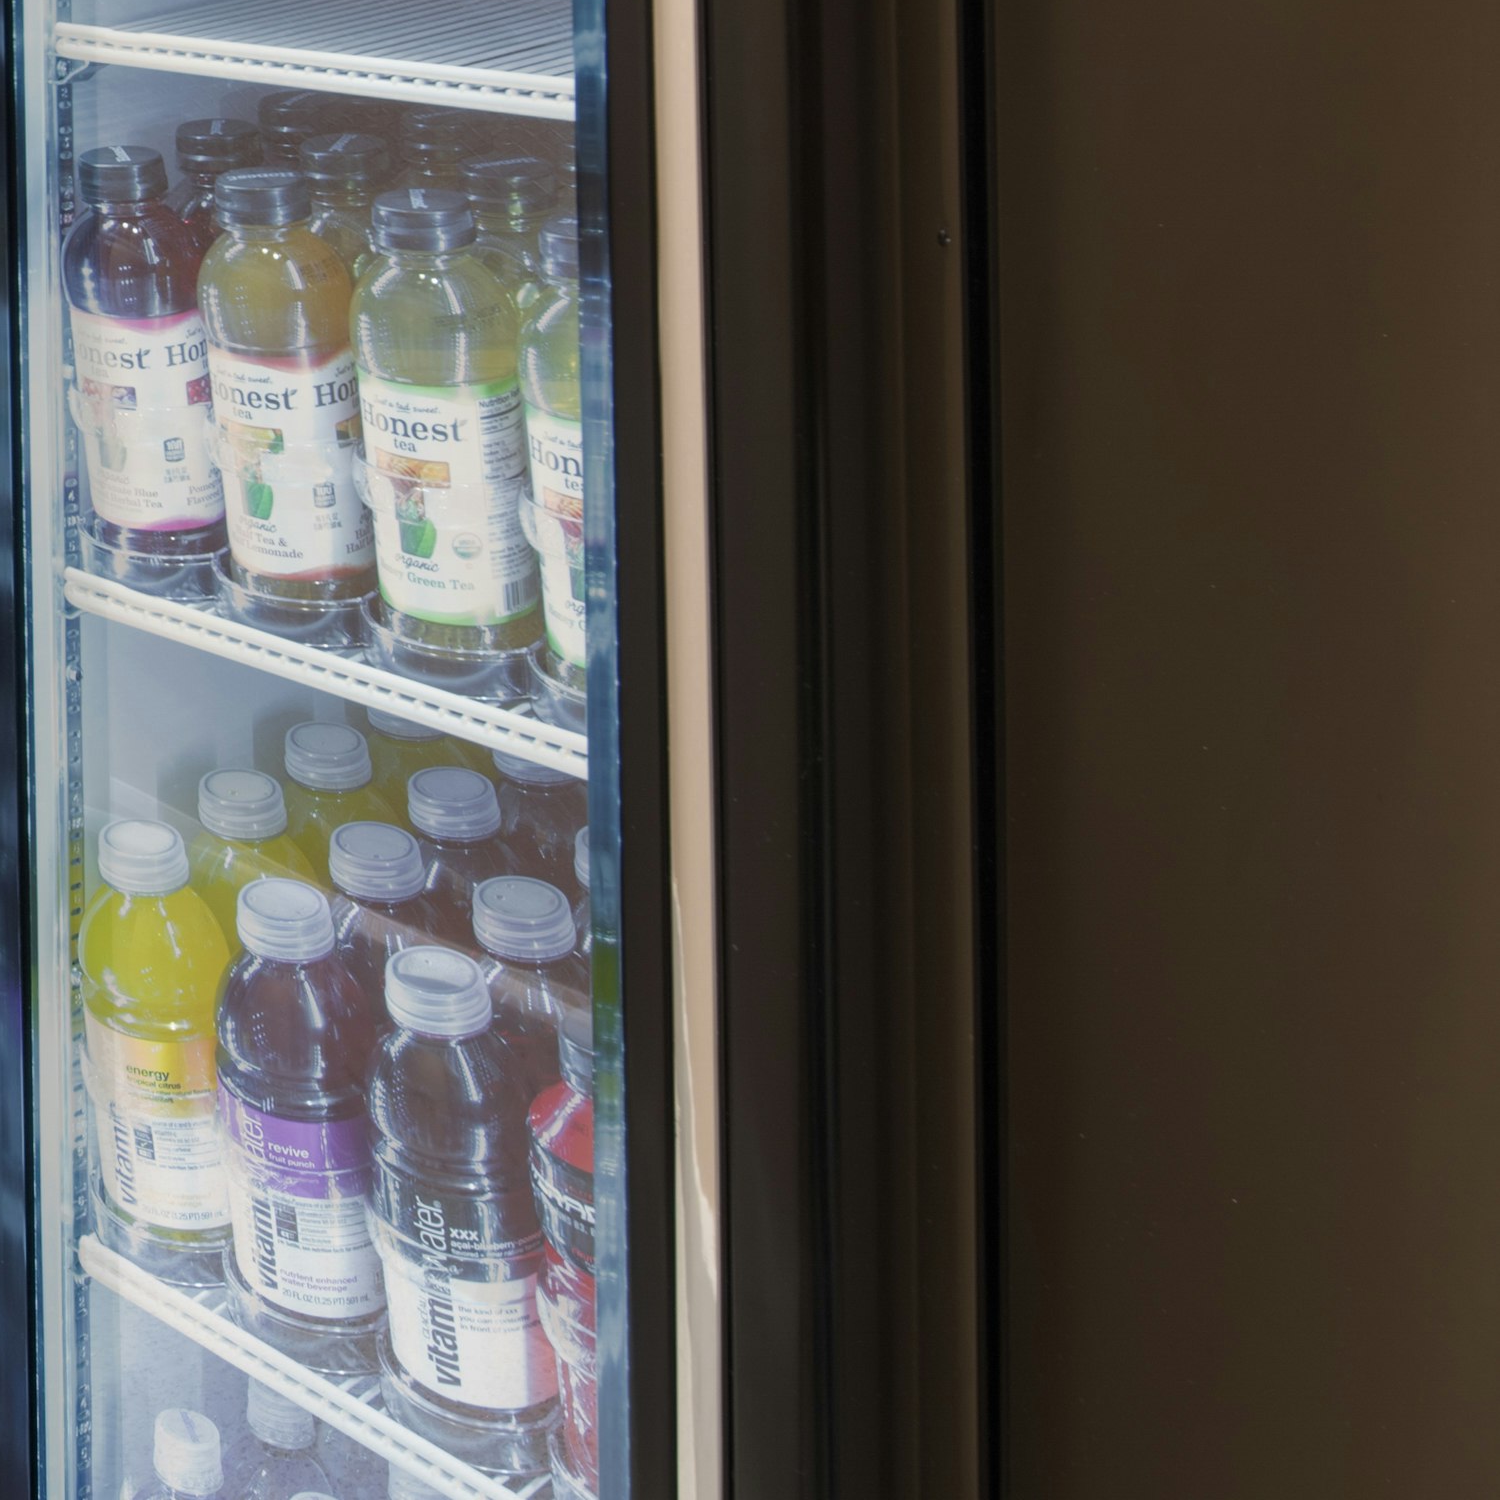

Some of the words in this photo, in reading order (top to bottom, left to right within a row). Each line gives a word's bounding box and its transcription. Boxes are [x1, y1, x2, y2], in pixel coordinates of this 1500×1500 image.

[77, 341, 150, 370] onest
[165, 338, 208, 368] Hon
[313, 376, 358, 408] Hon
[412, 404, 440, 414] sweet.
[479, 393, 510, 409] Nutrition
[233, 406, 253, 420] tea
[362, 397, 468, 442] Honest
[393, 437, 417, 453] tea
[528, 434, 582, 478] Hon
[144, 496, 162, 509] Tea
[246, 539, 303, 559] Lemonade
[257, 535, 275, 547] Tea
[278, 537, 288, 547] &
[396, 554, 439, 572] organic
[407, 572, 446, 589] Green
[449, 579, 475, 590] Tea
[126, 1064, 170, 1081] energy
[158, 1081, 181, 1090] citrus
[268, 1141, 309, 1159] revive
[269, 1153, 286, 1165] fruit
[287, 1157, 315, 1169] punch
[449, 1227, 478, 1240] xxx
[280, 1268, 313, 1283] nutrient
[315, 1274, 357, 1285] enhanced
[280, 1276, 304, 1288] water
[307, 1281, 348, 1293] beverage
[282, 1287, 292, 1298] 20
[293, 1289, 302, 1300] FL
[304, 1291, 313, 1302] OZ
[314, 1292, 332, 1305] (1.25
[474, 1307, 491, 1315] kind
[470, 1323, 490, 1332] front
